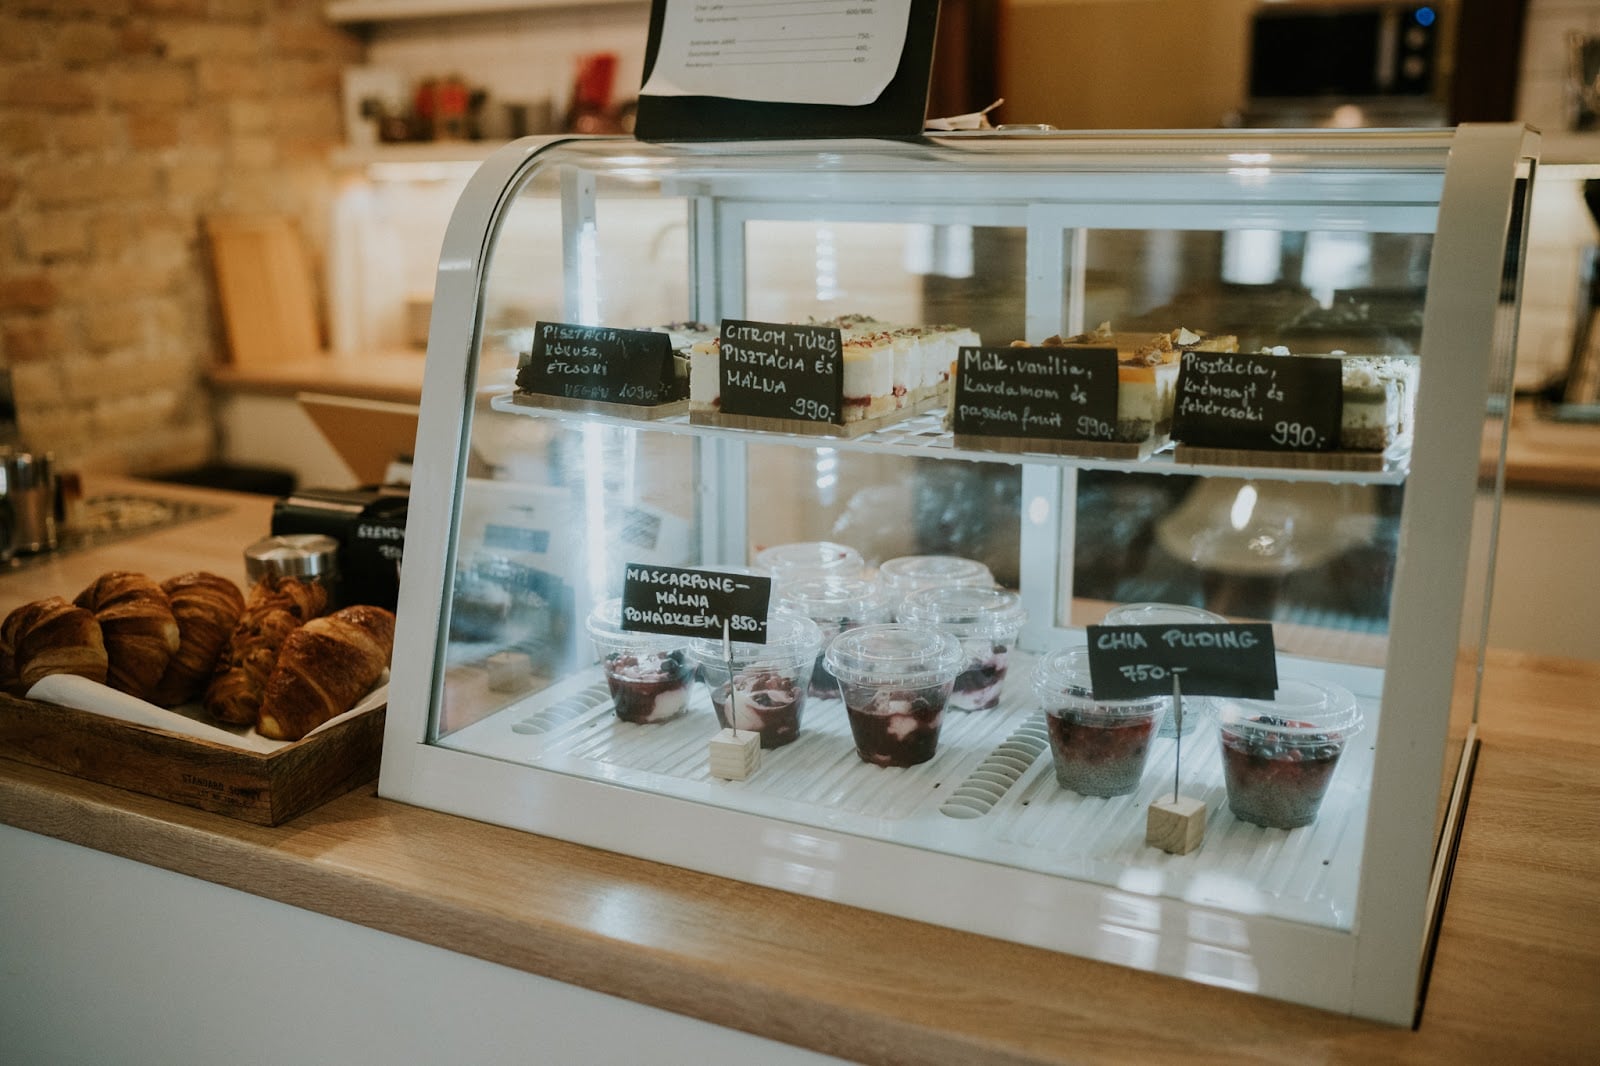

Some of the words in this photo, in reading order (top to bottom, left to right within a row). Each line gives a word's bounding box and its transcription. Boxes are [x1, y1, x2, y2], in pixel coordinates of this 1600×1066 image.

[726, 325, 794, 351] CITROM,
[721, 344, 805, 372] PISZTÁCIA
[815, 354, 833, 375] ÉS
[727, 369, 786, 394] MÁLNA
[1267, 382, 1284, 402] és
[1070, 384, 1088, 405] és
[959, 404, 1018, 422] passion
[1022, 406, 1063, 431] fruit
[1180, 396, 1264, 421] fehércsoki
[656, 588, 709, 608] MÁLNA
[624, 606, 722, 628] POHÁRKRÉM
[1097, 631, 1148, 650] CHIA
[1161, 629, 1259, 648] PUDING
